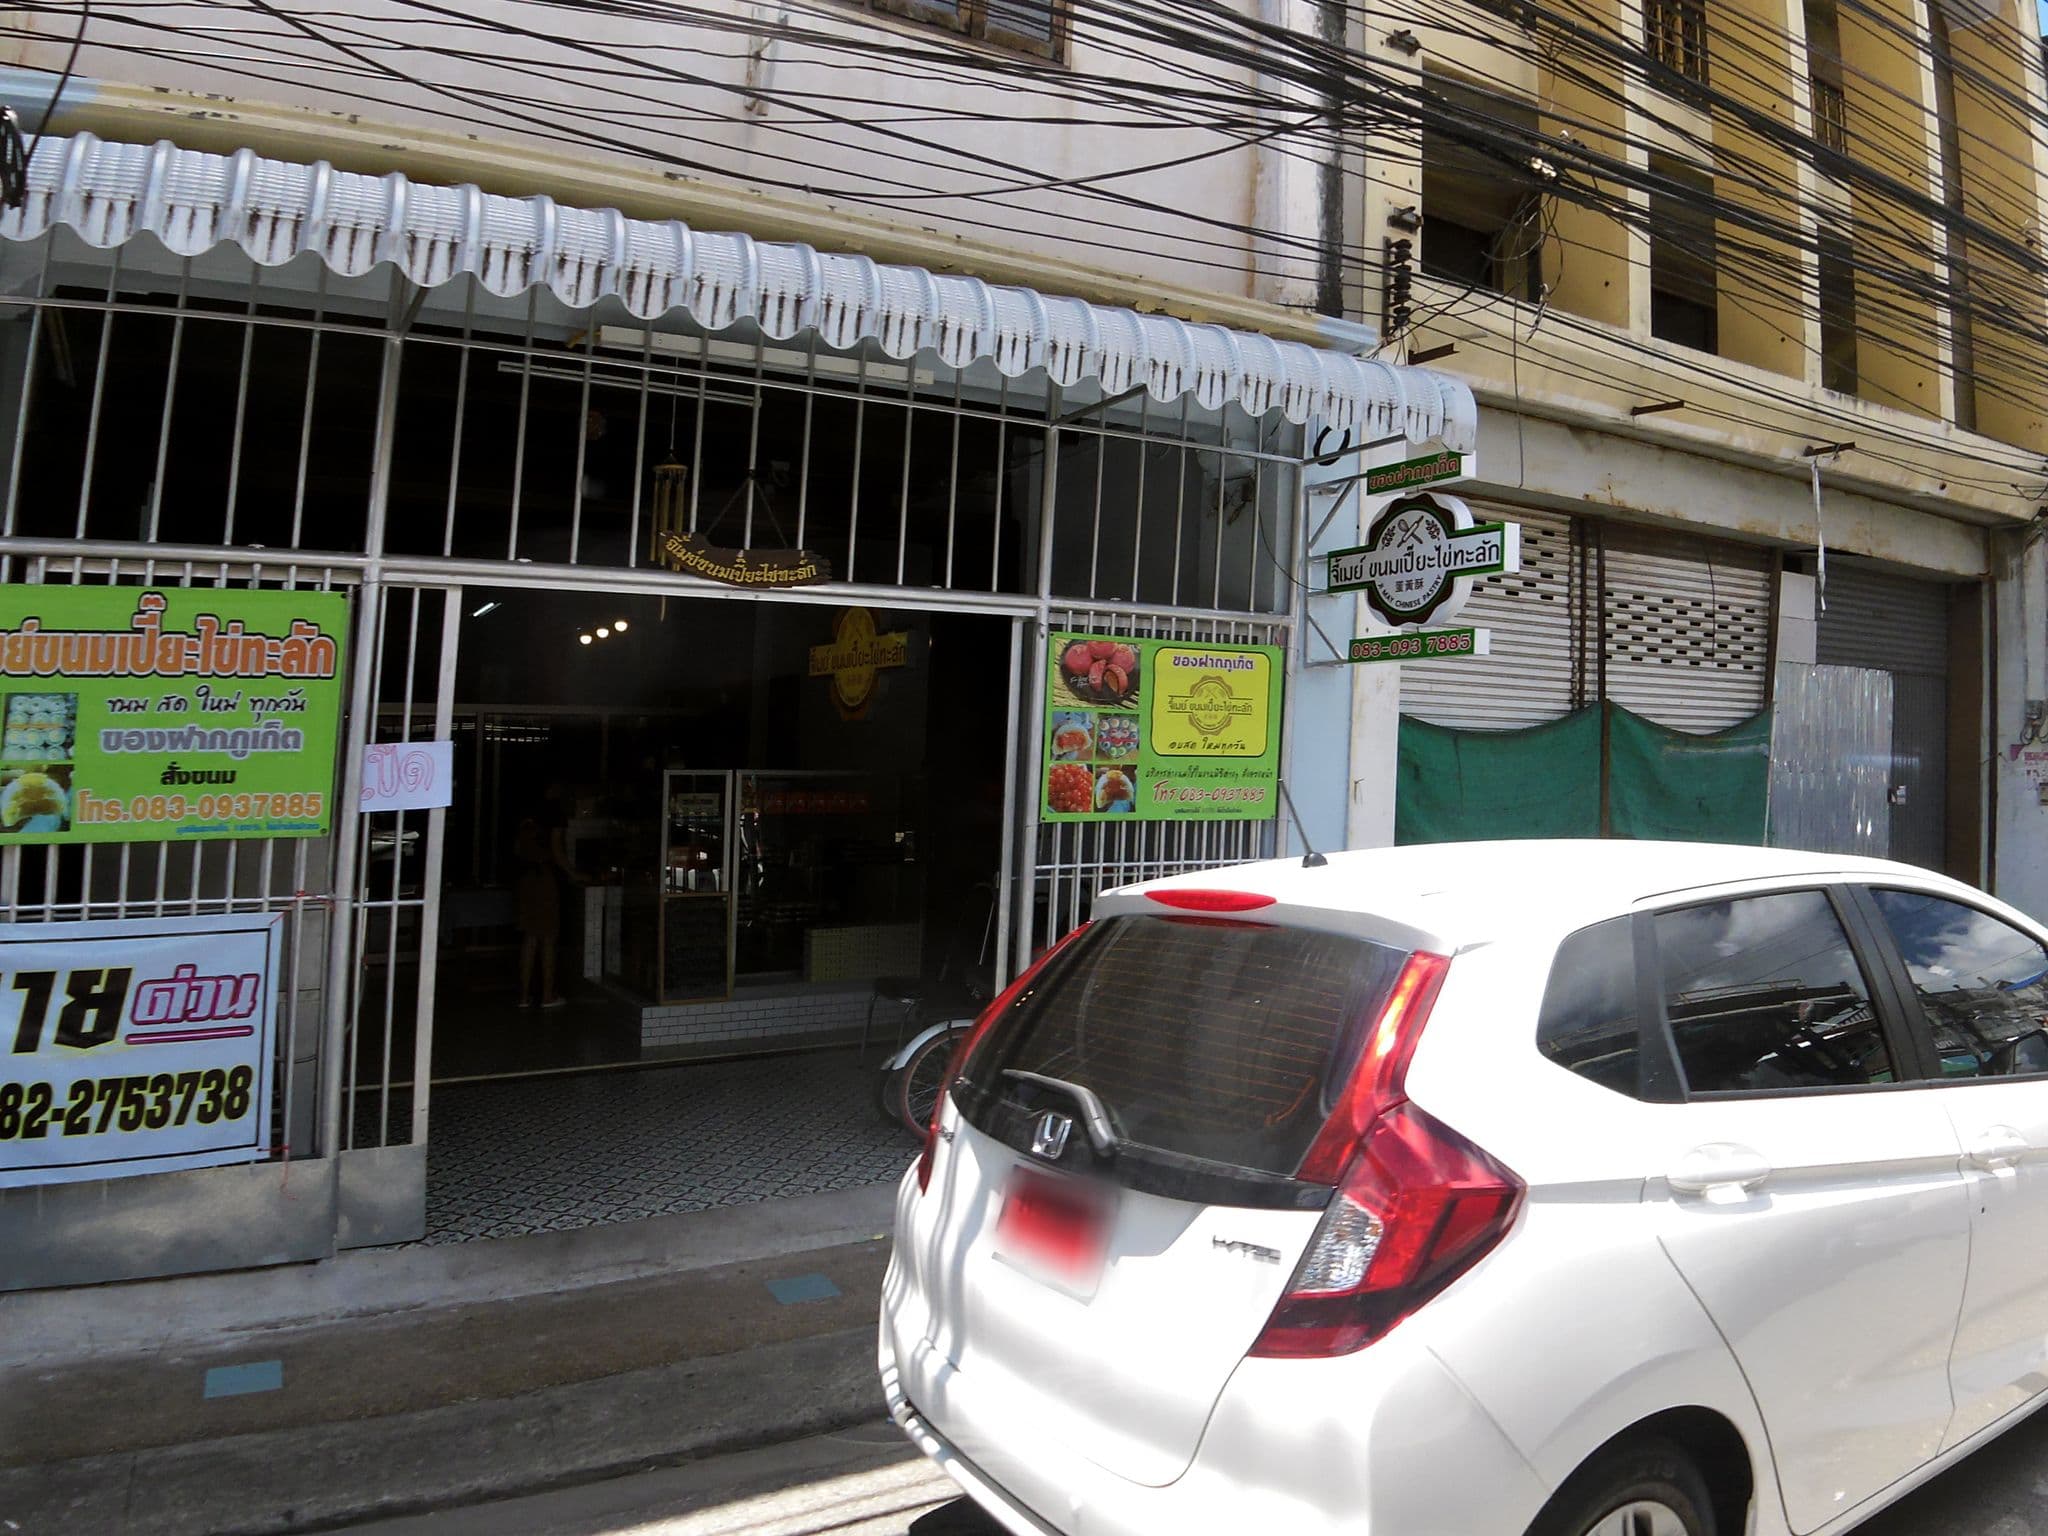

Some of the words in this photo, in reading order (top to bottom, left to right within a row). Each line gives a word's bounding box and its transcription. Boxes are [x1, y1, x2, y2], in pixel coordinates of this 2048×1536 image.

[1369, 453, 1458, 489] ของฝากภูเก็ต
[1331, 556, 1366, 584] จี้เมย์
[1369, 540, 1499, 578] ขนมเปี๊ยะไข่ทะลัก
[1382, 589, 1395, 602] MAY
[1395, 598, 1421, 608] CHINESE
[1422, 575, 1442, 602] PASTRY
[0, 592, 336, 677] ย์ขนมเปี๊ยะไข่ทะลัก
[1351, 639, 1420, 658] 083-093
[1427, 634, 1471, 653] 7885
[1172, 654, 1254, 672] ของฝากภูเก็ต
[196, 685, 241, 713] ใหม่
[250, 688, 306, 722] ทุกวัน
[101, 719, 305, 760] ของฝากภูเก็ต
[160, 762, 237, 785] สั่งขนม
[76, 788, 323, 824] โทร.083-0937885
[0, 967, 133, 1054] าย
[130, 964, 260, 1025] ด่วน
